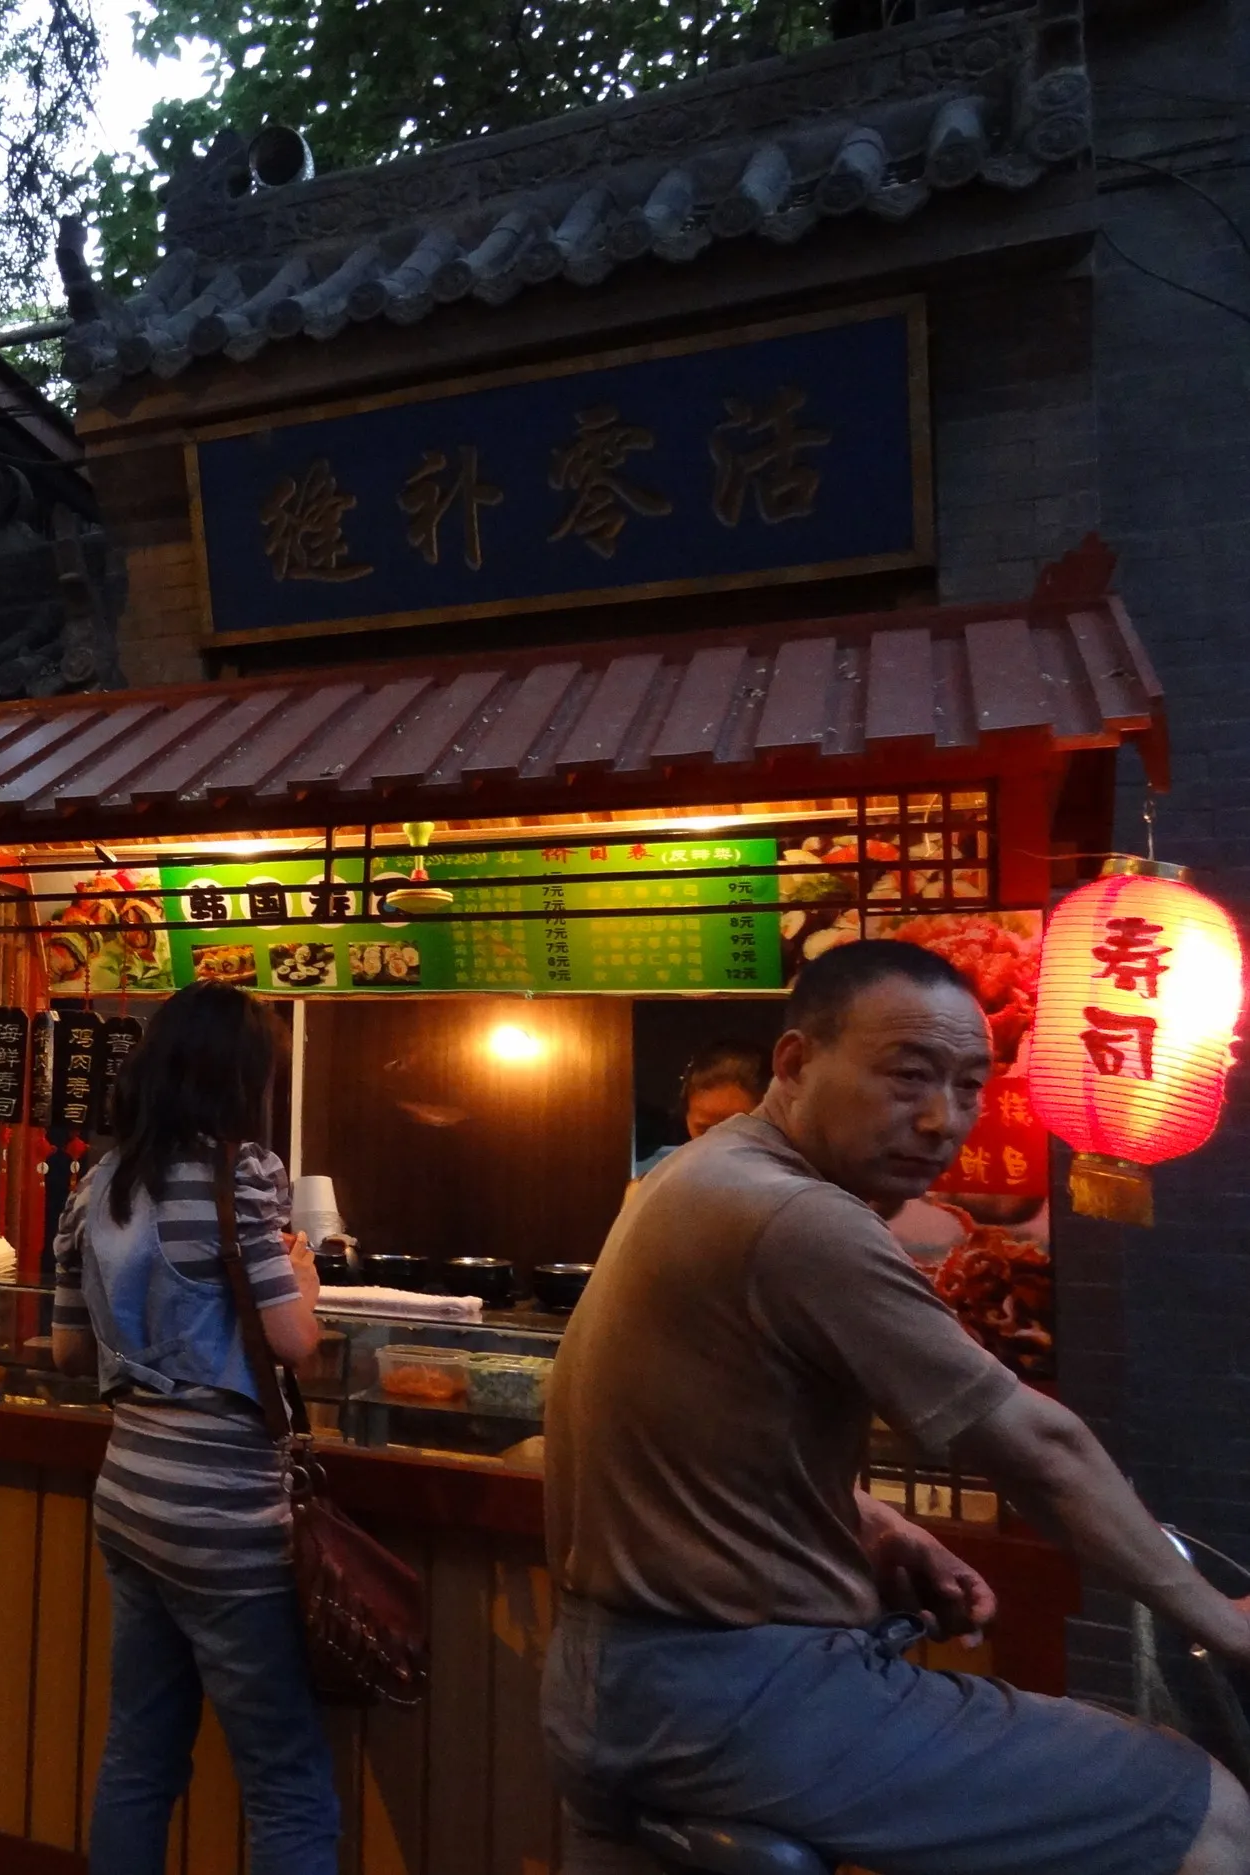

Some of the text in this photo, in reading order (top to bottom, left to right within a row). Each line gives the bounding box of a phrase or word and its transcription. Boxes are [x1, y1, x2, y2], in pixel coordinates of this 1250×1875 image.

[260, 387, 833, 583] 缝补零活
[542, 886, 565, 897] 7元
[728, 881, 753, 893] 9元
[730, 917, 755, 929] 8元
[545, 928, 568, 940] 7元
[731, 933, 756, 946] 9元
[546, 942, 569, 954] 7元
[1079, 917, 1173, 1081] 寿司
[63, 1028, 95, 1124] 鸡肉寿司
